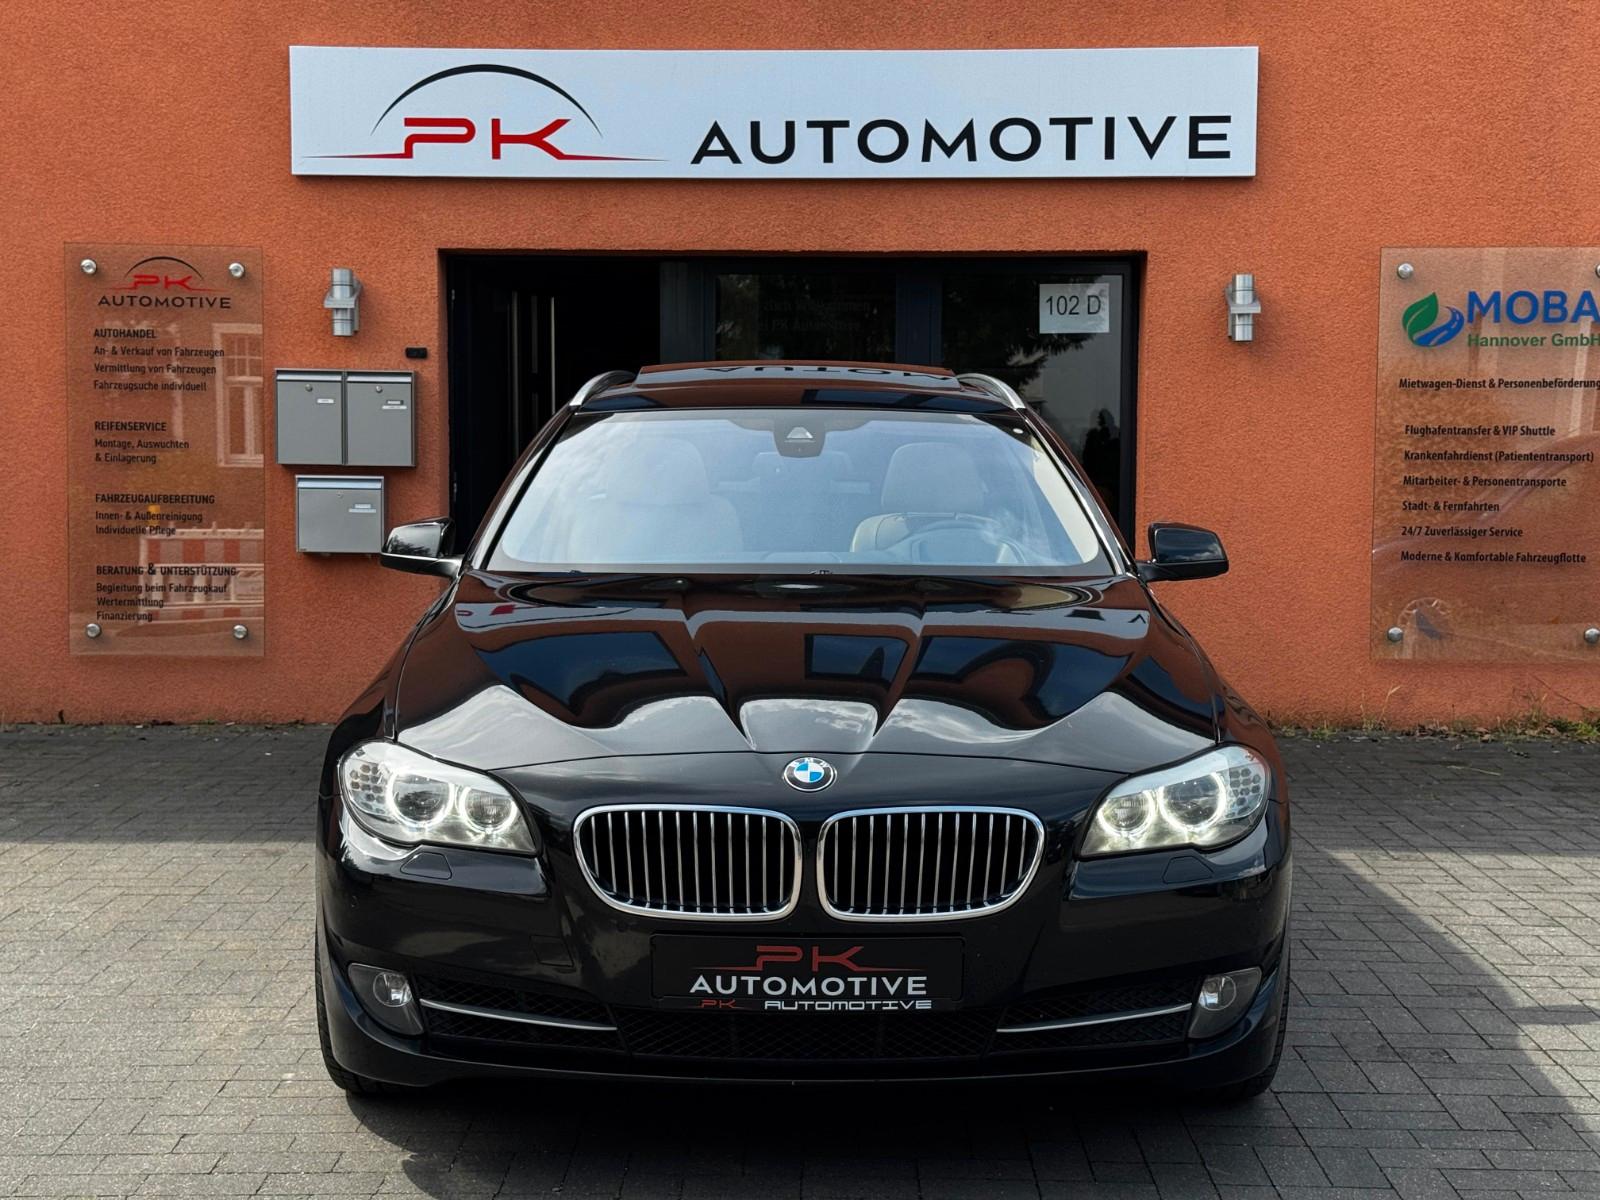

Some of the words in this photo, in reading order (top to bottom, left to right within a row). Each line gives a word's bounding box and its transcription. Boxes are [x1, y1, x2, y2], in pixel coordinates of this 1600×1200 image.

[404, 117, 572, 160] PK
[691, 114, 1233, 164] AUTOMOTIVE
[133, 274, 193, 290] PK
[98, 295, 231, 309] AUTOMOTIVE
[1046, 295, 1080, 315] 102
[1087, 294, 1102, 315] D
[1467, 290, 1600, 325] MOBA
[94, 328, 158, 339] AUTOHANDEL
[1468, 333, 1546, 347] Hannover
[1551, 333, 1600, 347] GmbH
[94, 346, 108, 356] An-
[111, 346, 118, 356] &
[120, 346, 154, 356] Verkauf
[157, 348, 172, 356] von
[174, 346, 225, 359] Fahrzeugen
[94, 364, 146, 374] Vermittlung
[149, 366, 164, 374] von
[166, 364, 217, 375] Fahrzeugen
[94, 380, 159, 392] Fahrzeugsuche
[161, 381, 207, 392] individuell
[1399, 378, 1486, 389] Mietwagen-Dienst
[1488, 379, 1496, 389] &
[1498, 378, 1600, 390] Personenbeförderung
[95, 421, 167, 432] REIFENSERVICE
[1404, 425, 1491, 437] Flughafentransfer
[1493, 426, 1500, 436] &
[1502, 426, 1518, 436] VIP
[1520, 425, 1556, 436] Shuttle
[95, 439, 134, 450] Montage,
[136, 439, 189, 449] Auswuchten
[95, 453, 101, 462] &
[104, 453, 157, 464] Einlagerung
[1404, 450, 1493, 461] Krankenfahrdienst
[1495, 451, 1594, 463] (Patiententransport)
[1403, 475, 1461, 486] Mitarbeiter-
[1463, 476, 1470, 486] &
[1472, 476, 1567, 488] Personentransporte
[95, 493, 215, 504] FAHRZEUGAUFBEREITUNG
[1402, 500, 1432, 511] Stadt-
[1433, 501, 1441, 511] &
[1443, 501, 1500, 512] Fernfahrten
[95, 511, 124, 520] Innen-
[125, 511, 132, 521] &
[134, 511, 203, 523] Außenreinigung
[96, 525, 147, 535] Individuelle
[149, 526, 176, 537] Pflege
[1401, 526, 1423, 537] 24/7
[1424, 526, 1487, 539] Zuverlässiger
[1489, 526, 1523, 537] Service
[1400, 551, 1442, 561] Moderne
[1444, 552, 1451, 562] &
[1454, 551, 1514, 562] Komfortable
[1516, 552, 1586, 565] Fahrzeugflotte
[96, 565, 144, 576] BERATUNG
[147, 562, 157, 576] &
[160, 564, 237, 576] UNTERSTÜTZUNG
[96, 583, 142, 594] Begleitung
[145, 584, 166, 593] beim
[169, 583, 228, 594] Fahrzeugkauf
[97, 597, 164, 608] Wertermittlung
[97, 612, 153, 622] Finanzierung
[756, 945, 864, 972] PK
[689, 975, 927, 996] AUTOMOTIVE
[701, 999, 736, 1009] PK
[764, 999, 932, 1010] AUTOMOTIVE
